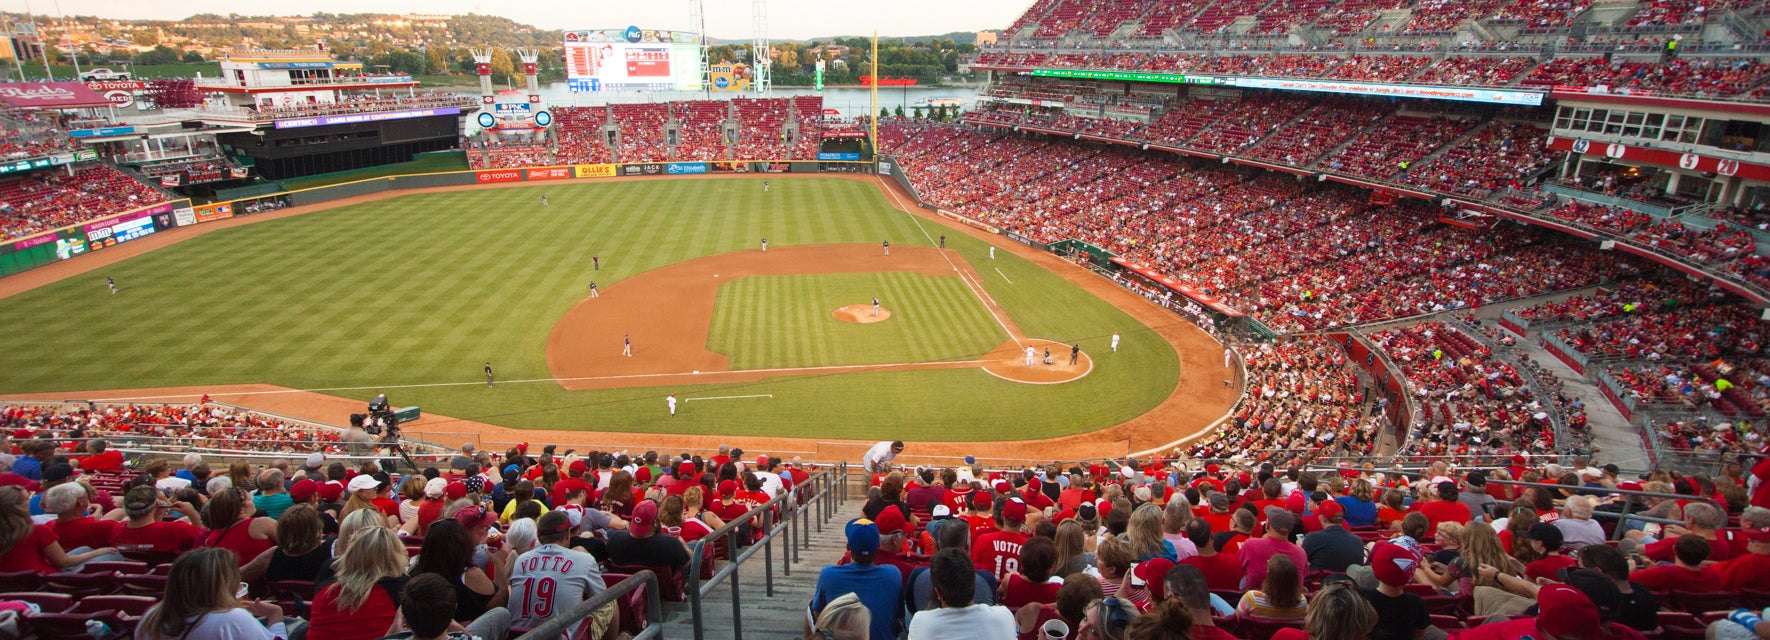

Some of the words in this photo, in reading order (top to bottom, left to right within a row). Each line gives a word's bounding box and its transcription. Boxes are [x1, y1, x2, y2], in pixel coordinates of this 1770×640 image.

[283, 119, 313, 127] CENTRIC
[326, 116, 346, 124] LEARN
[1573, 141, 1585, 152] 42
[1684, 154, 1693, 167] 5
[1719, 160, 1735, 173] 20
[581, 165, 610, 174] OLLIE'S
[521, 555, 574, 574] VOTTO
[521, 577, 557, 618] 19
